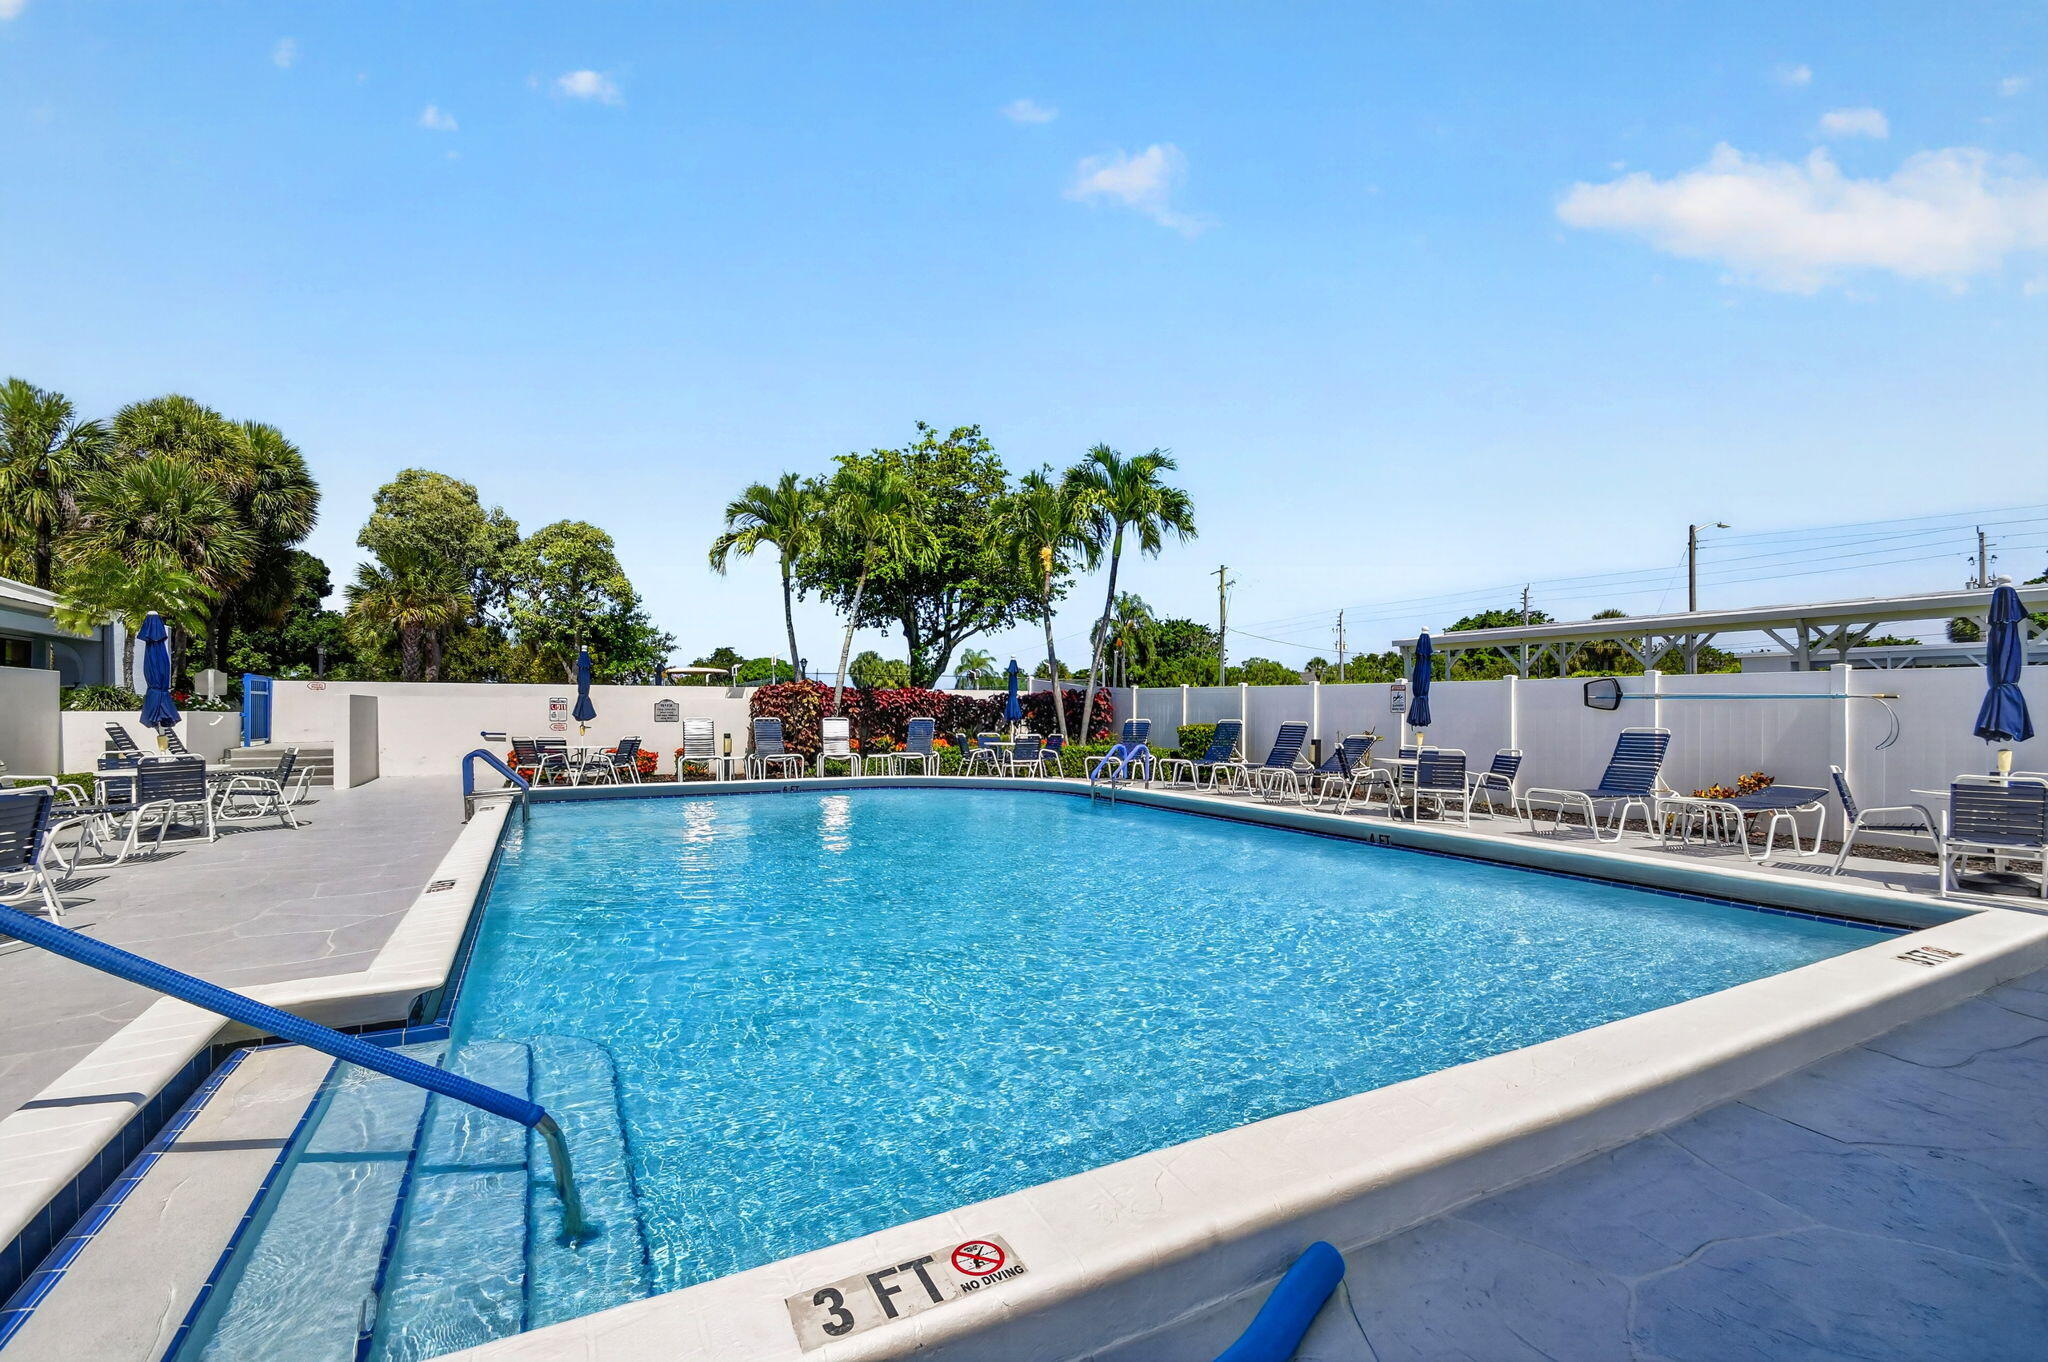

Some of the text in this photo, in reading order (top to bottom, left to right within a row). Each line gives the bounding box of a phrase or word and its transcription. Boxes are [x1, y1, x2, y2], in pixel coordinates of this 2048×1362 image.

[1379, 834, 1391, 845] FT
[960, 1264, 1025, 1293] NO DIVING
[813, 1255, 944, 1337] 3 FT
